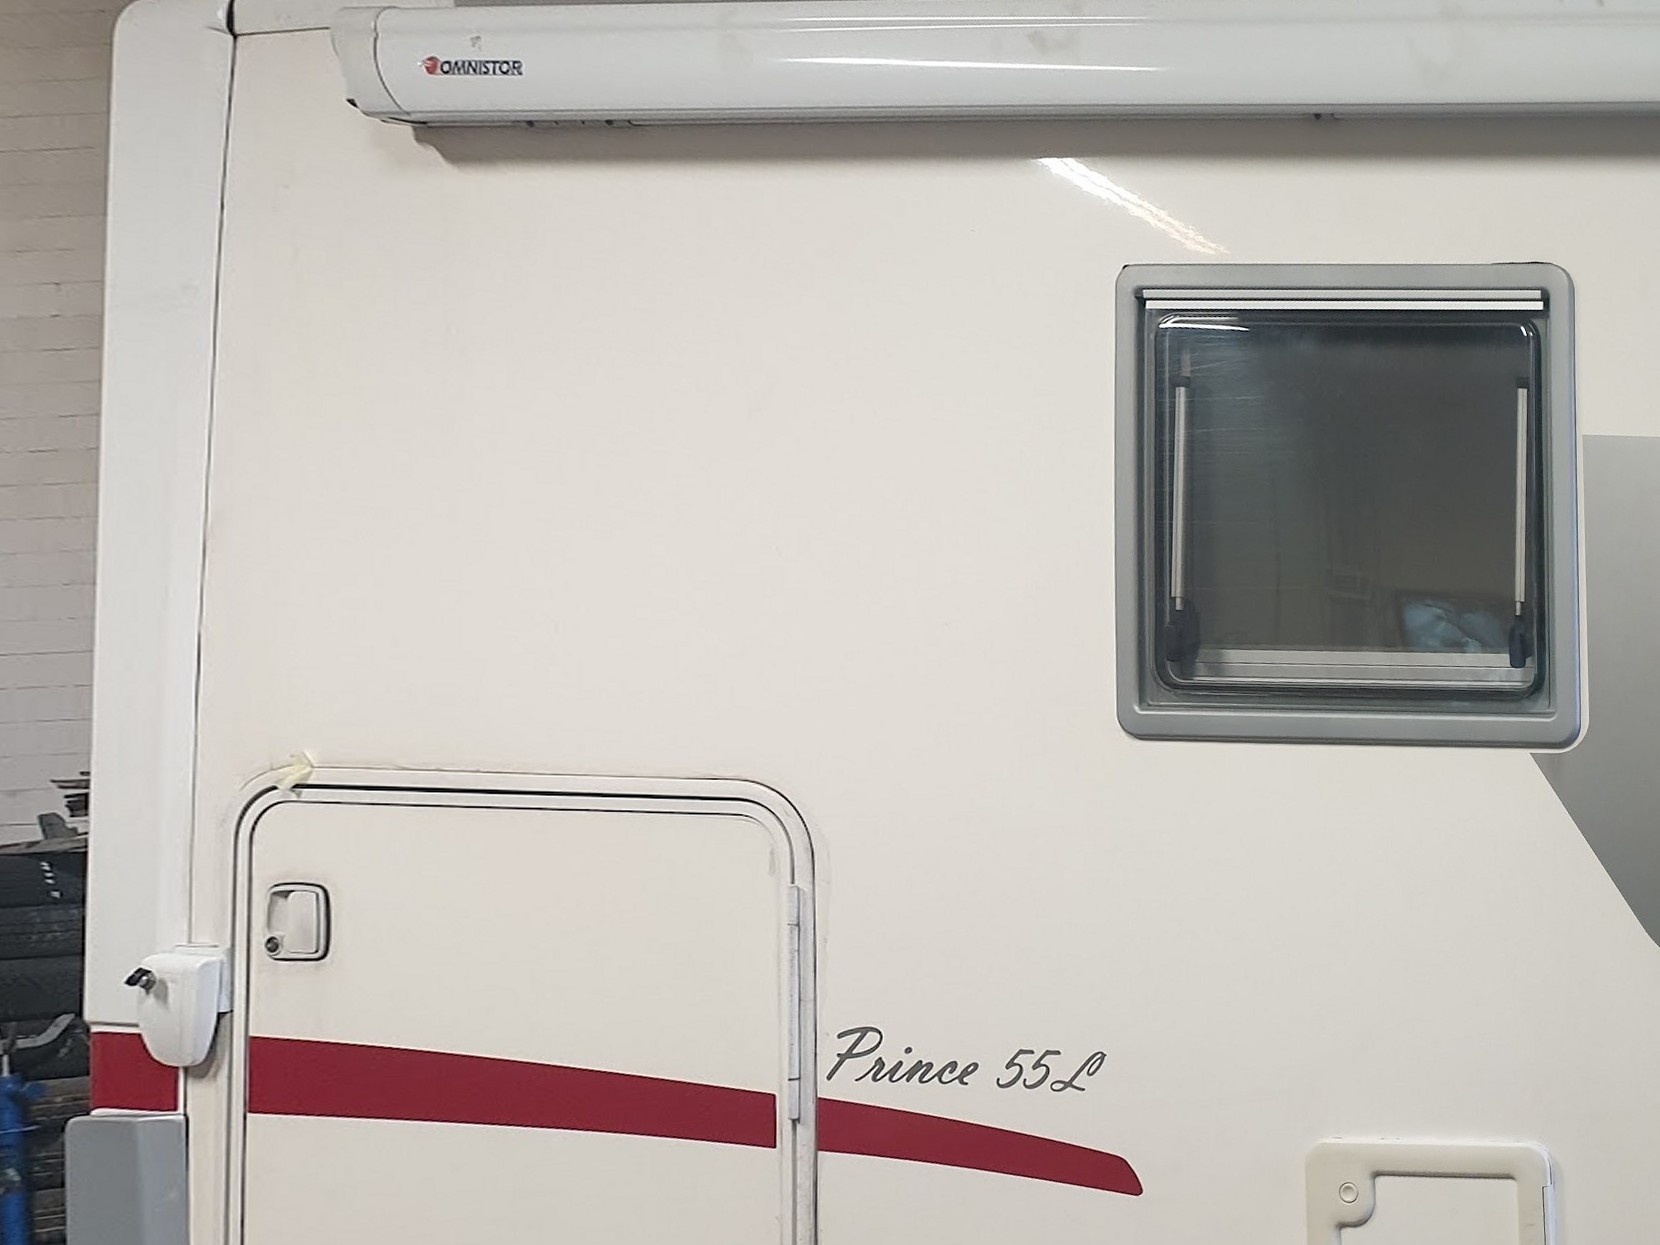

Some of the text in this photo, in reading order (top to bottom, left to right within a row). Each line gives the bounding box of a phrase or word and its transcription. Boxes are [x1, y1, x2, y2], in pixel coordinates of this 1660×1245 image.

[440, 60, 523, 75] OMNISTOR
[826, 1026, 1107, 1092] Prince 55L
